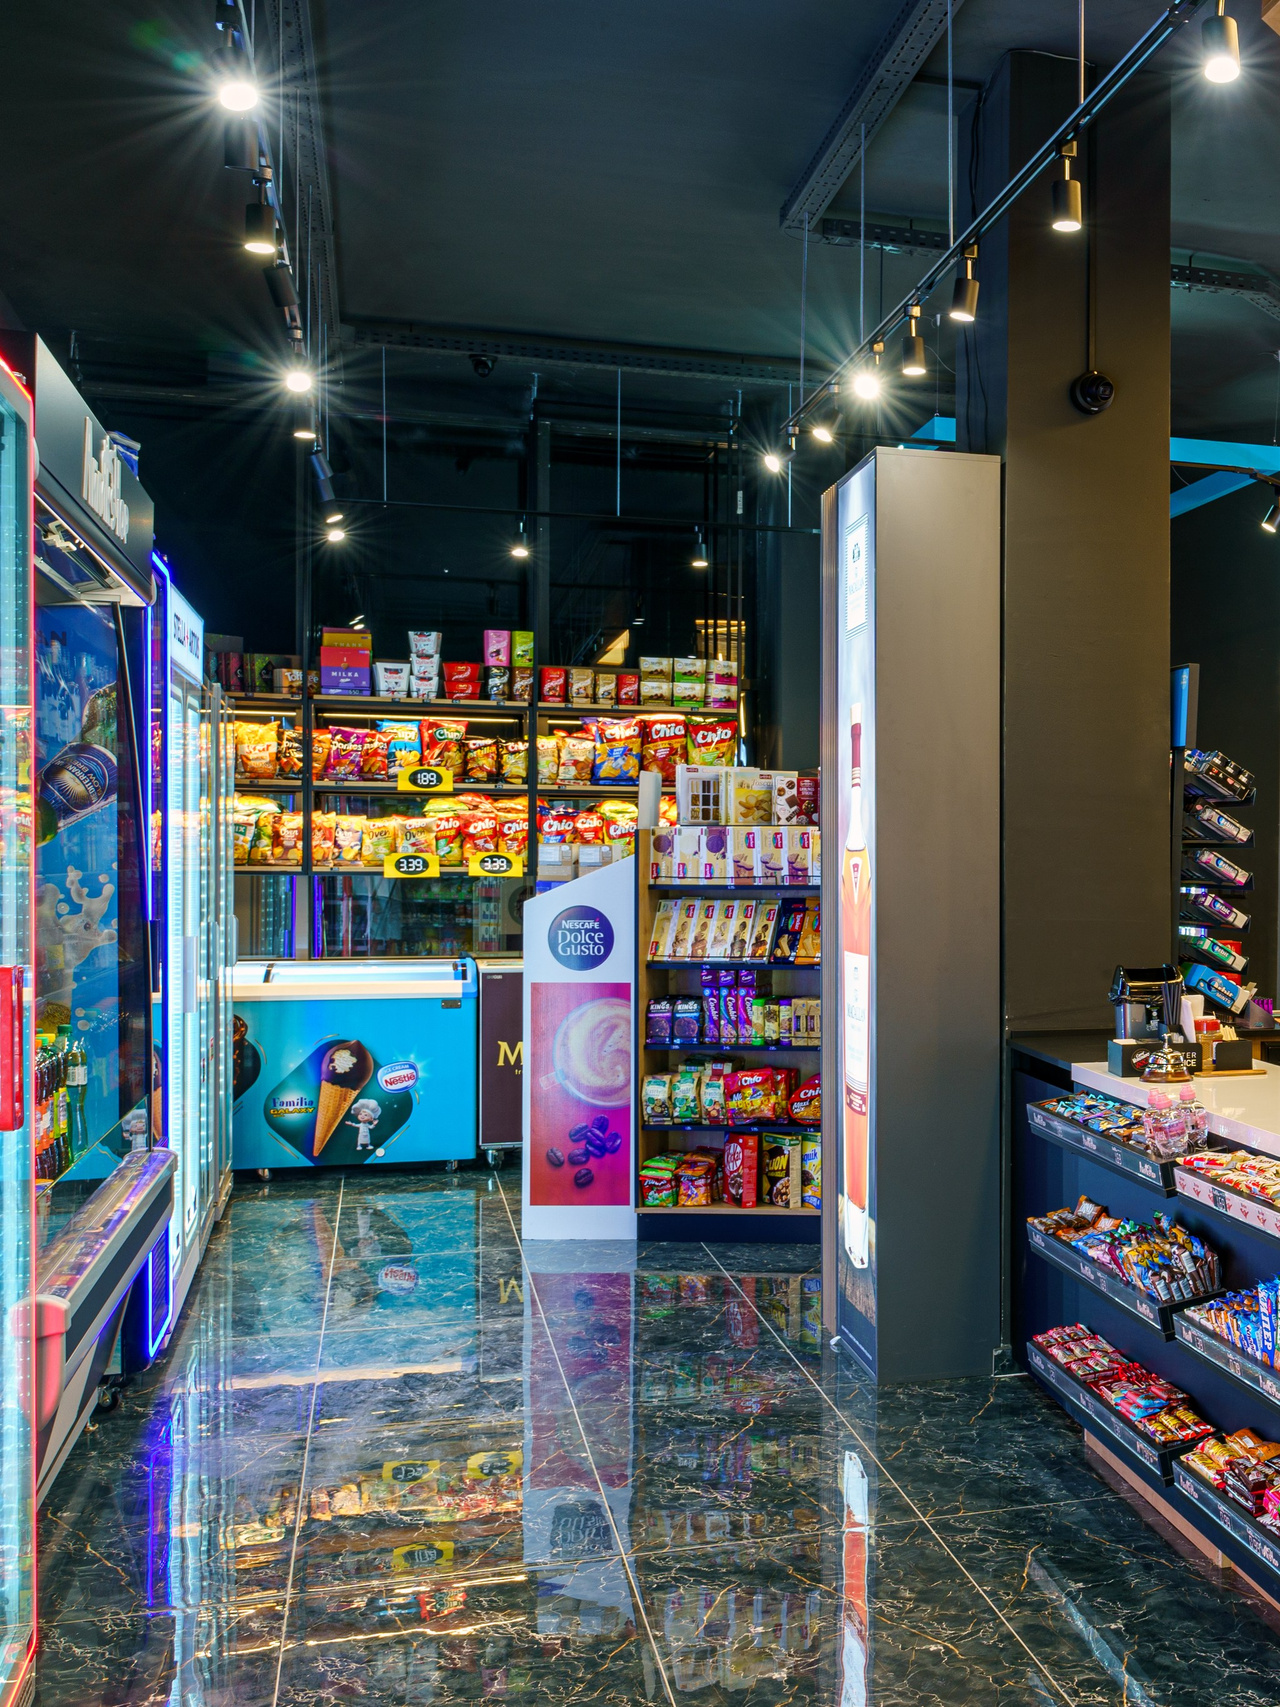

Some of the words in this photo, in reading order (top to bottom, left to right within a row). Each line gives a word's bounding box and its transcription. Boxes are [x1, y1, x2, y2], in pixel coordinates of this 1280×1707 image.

[651, 723, 685, 740] Chio
[696, 726, 732, 745] Chio
[417, 772, 437, 785] 1.89
[469, 819, 496, 834] Chio
[543, 820, 574, 832] Chio
[400, 858, 423, 871] 3.39
[483, 857, 507, 870] 3.39
[561, 917, 600, 930] NESCAFÉ
[558, 929, 604, 945] Dolce
[558, 941, 605, 957] Gusto
[272, 1096, 314, 1109] Familia
[269, 1107, 316, 1116] GALAXY
[769, 1155, 788, 1171] LION
